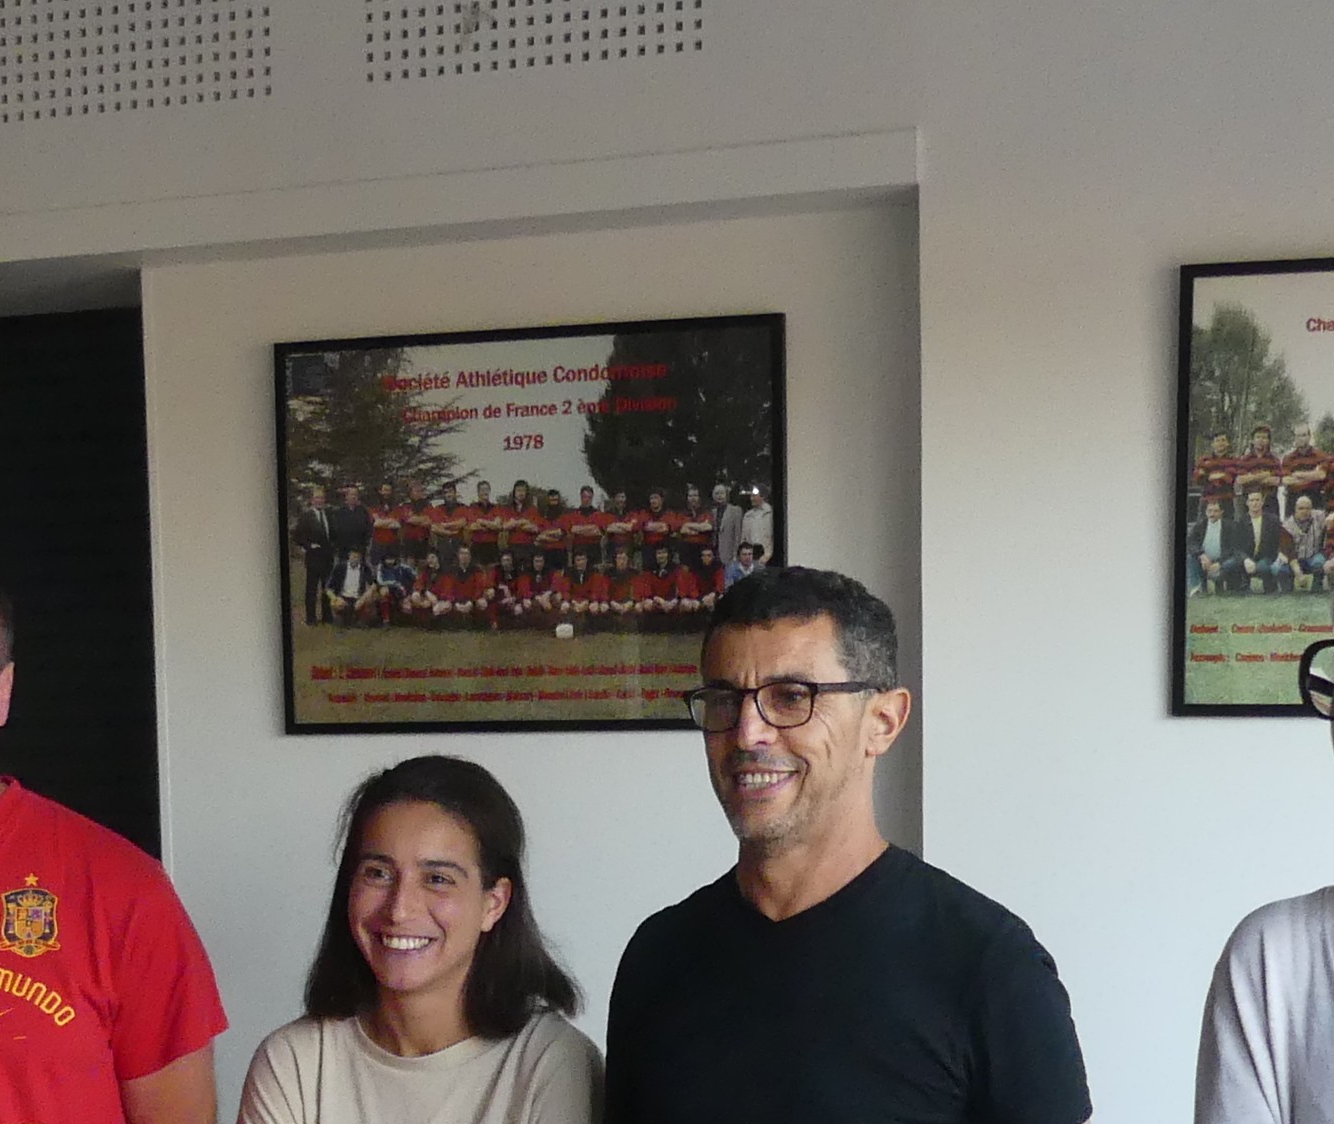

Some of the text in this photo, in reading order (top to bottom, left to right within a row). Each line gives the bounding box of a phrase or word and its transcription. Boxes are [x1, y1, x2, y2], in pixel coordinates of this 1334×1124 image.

[383, 372, 451, 393] Société
[456, 367, 548, 390] Athlétique
[403, 405, 479, 424] Champion
[483, 404, 502, 418] de
[506, 402, 558, 418] France
[562, 400, 573, 415] 2
[503, 434, 545, 450] 1978
